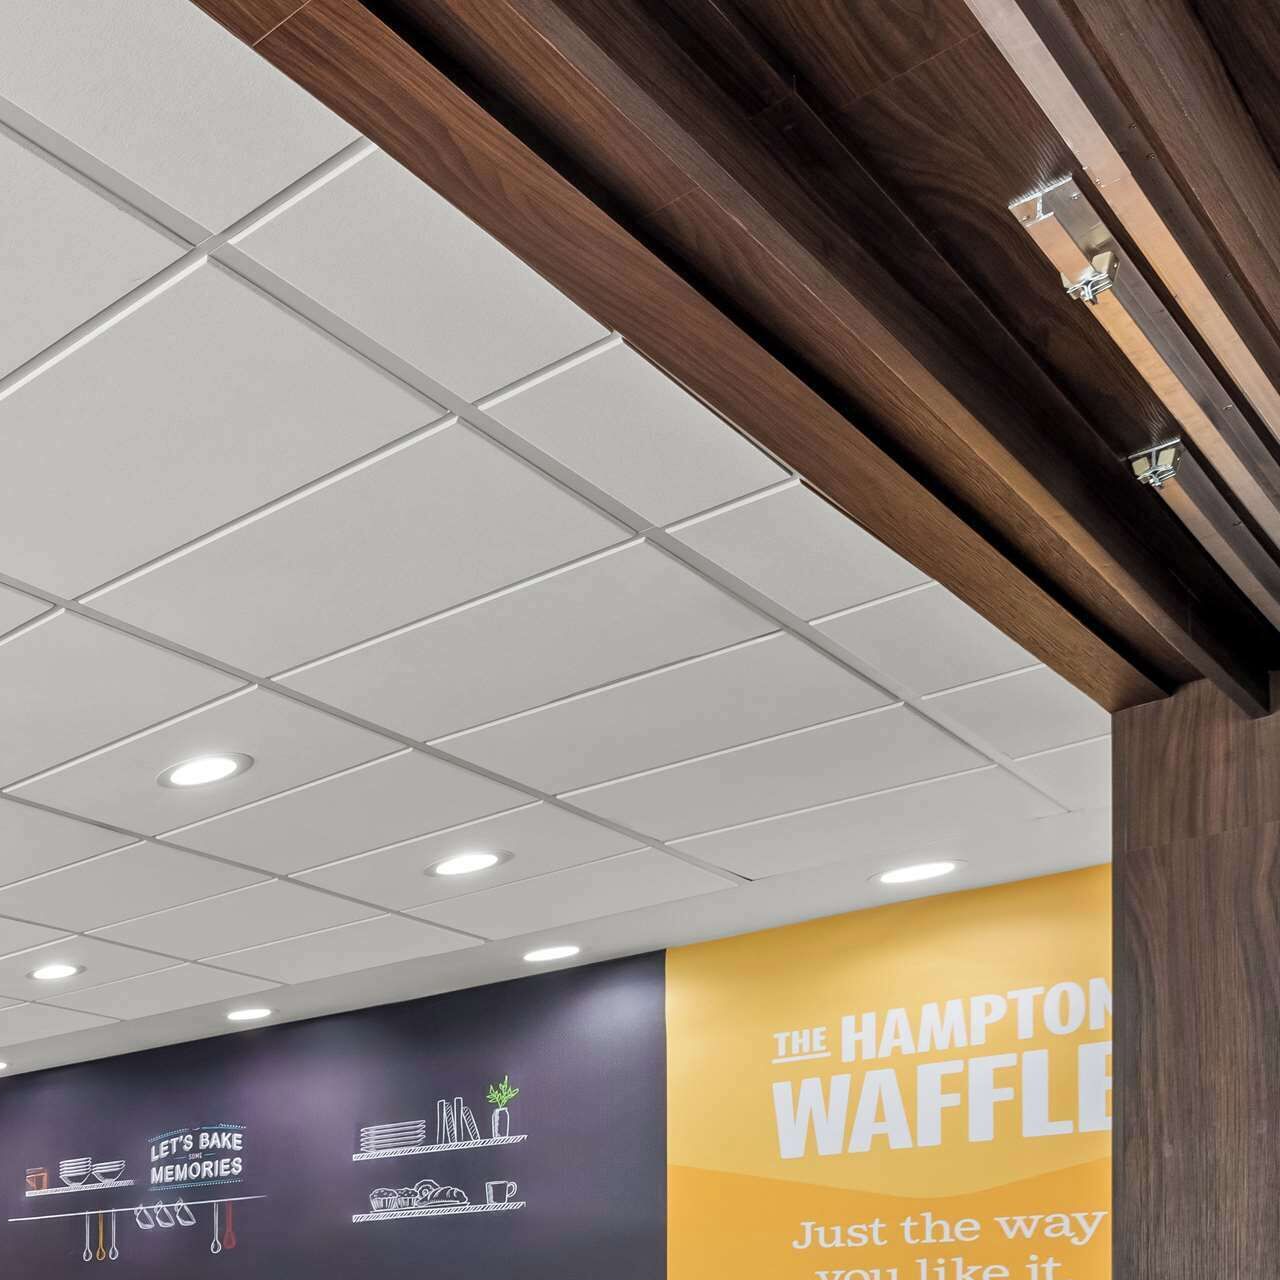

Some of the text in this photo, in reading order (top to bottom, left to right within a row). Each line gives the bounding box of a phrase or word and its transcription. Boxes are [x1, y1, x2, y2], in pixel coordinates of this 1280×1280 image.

[772, 976, 1112, 1064] THE HAMPTON
[772, 1041, 1112, 1159] WAFFLE
[151, 1132, 243, 1162] LET'S BAKE
[188, 1152, 203, 1160] SOME
[151, 1157, 243, 1184] MEMORIES
[791, 1211, 1109, 1250] Just the way
